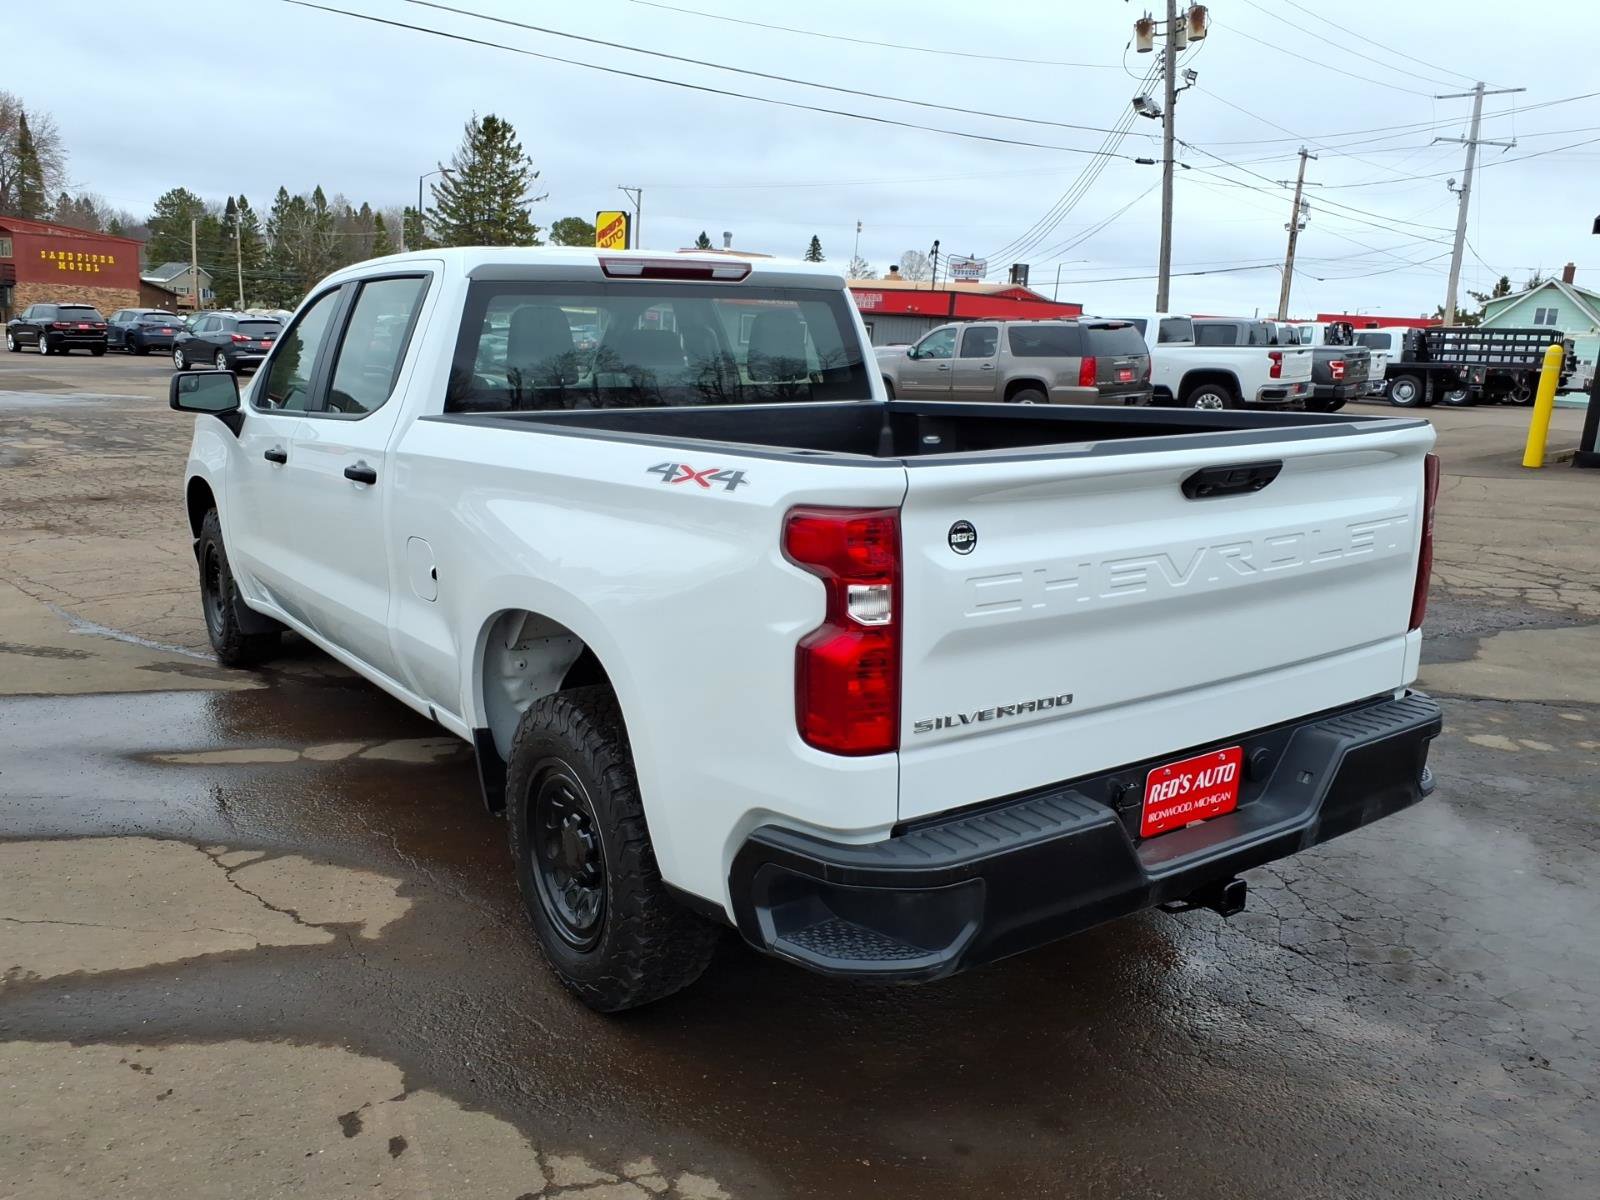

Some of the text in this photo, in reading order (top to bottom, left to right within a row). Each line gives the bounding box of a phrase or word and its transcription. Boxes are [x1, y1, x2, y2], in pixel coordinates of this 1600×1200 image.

[40, 250, 115, 264] SANDPIPER
[58, 261, 100, 272] MOTEL
[964, 513, 1409, 617] CHEVROLET
[913, 692, 1074, 734] SILVERADO
[1148, 762, 1236, 805] RED'S AUTO
[1147, 791, 1232, 823] IRONWOOD, MICHIGAN
